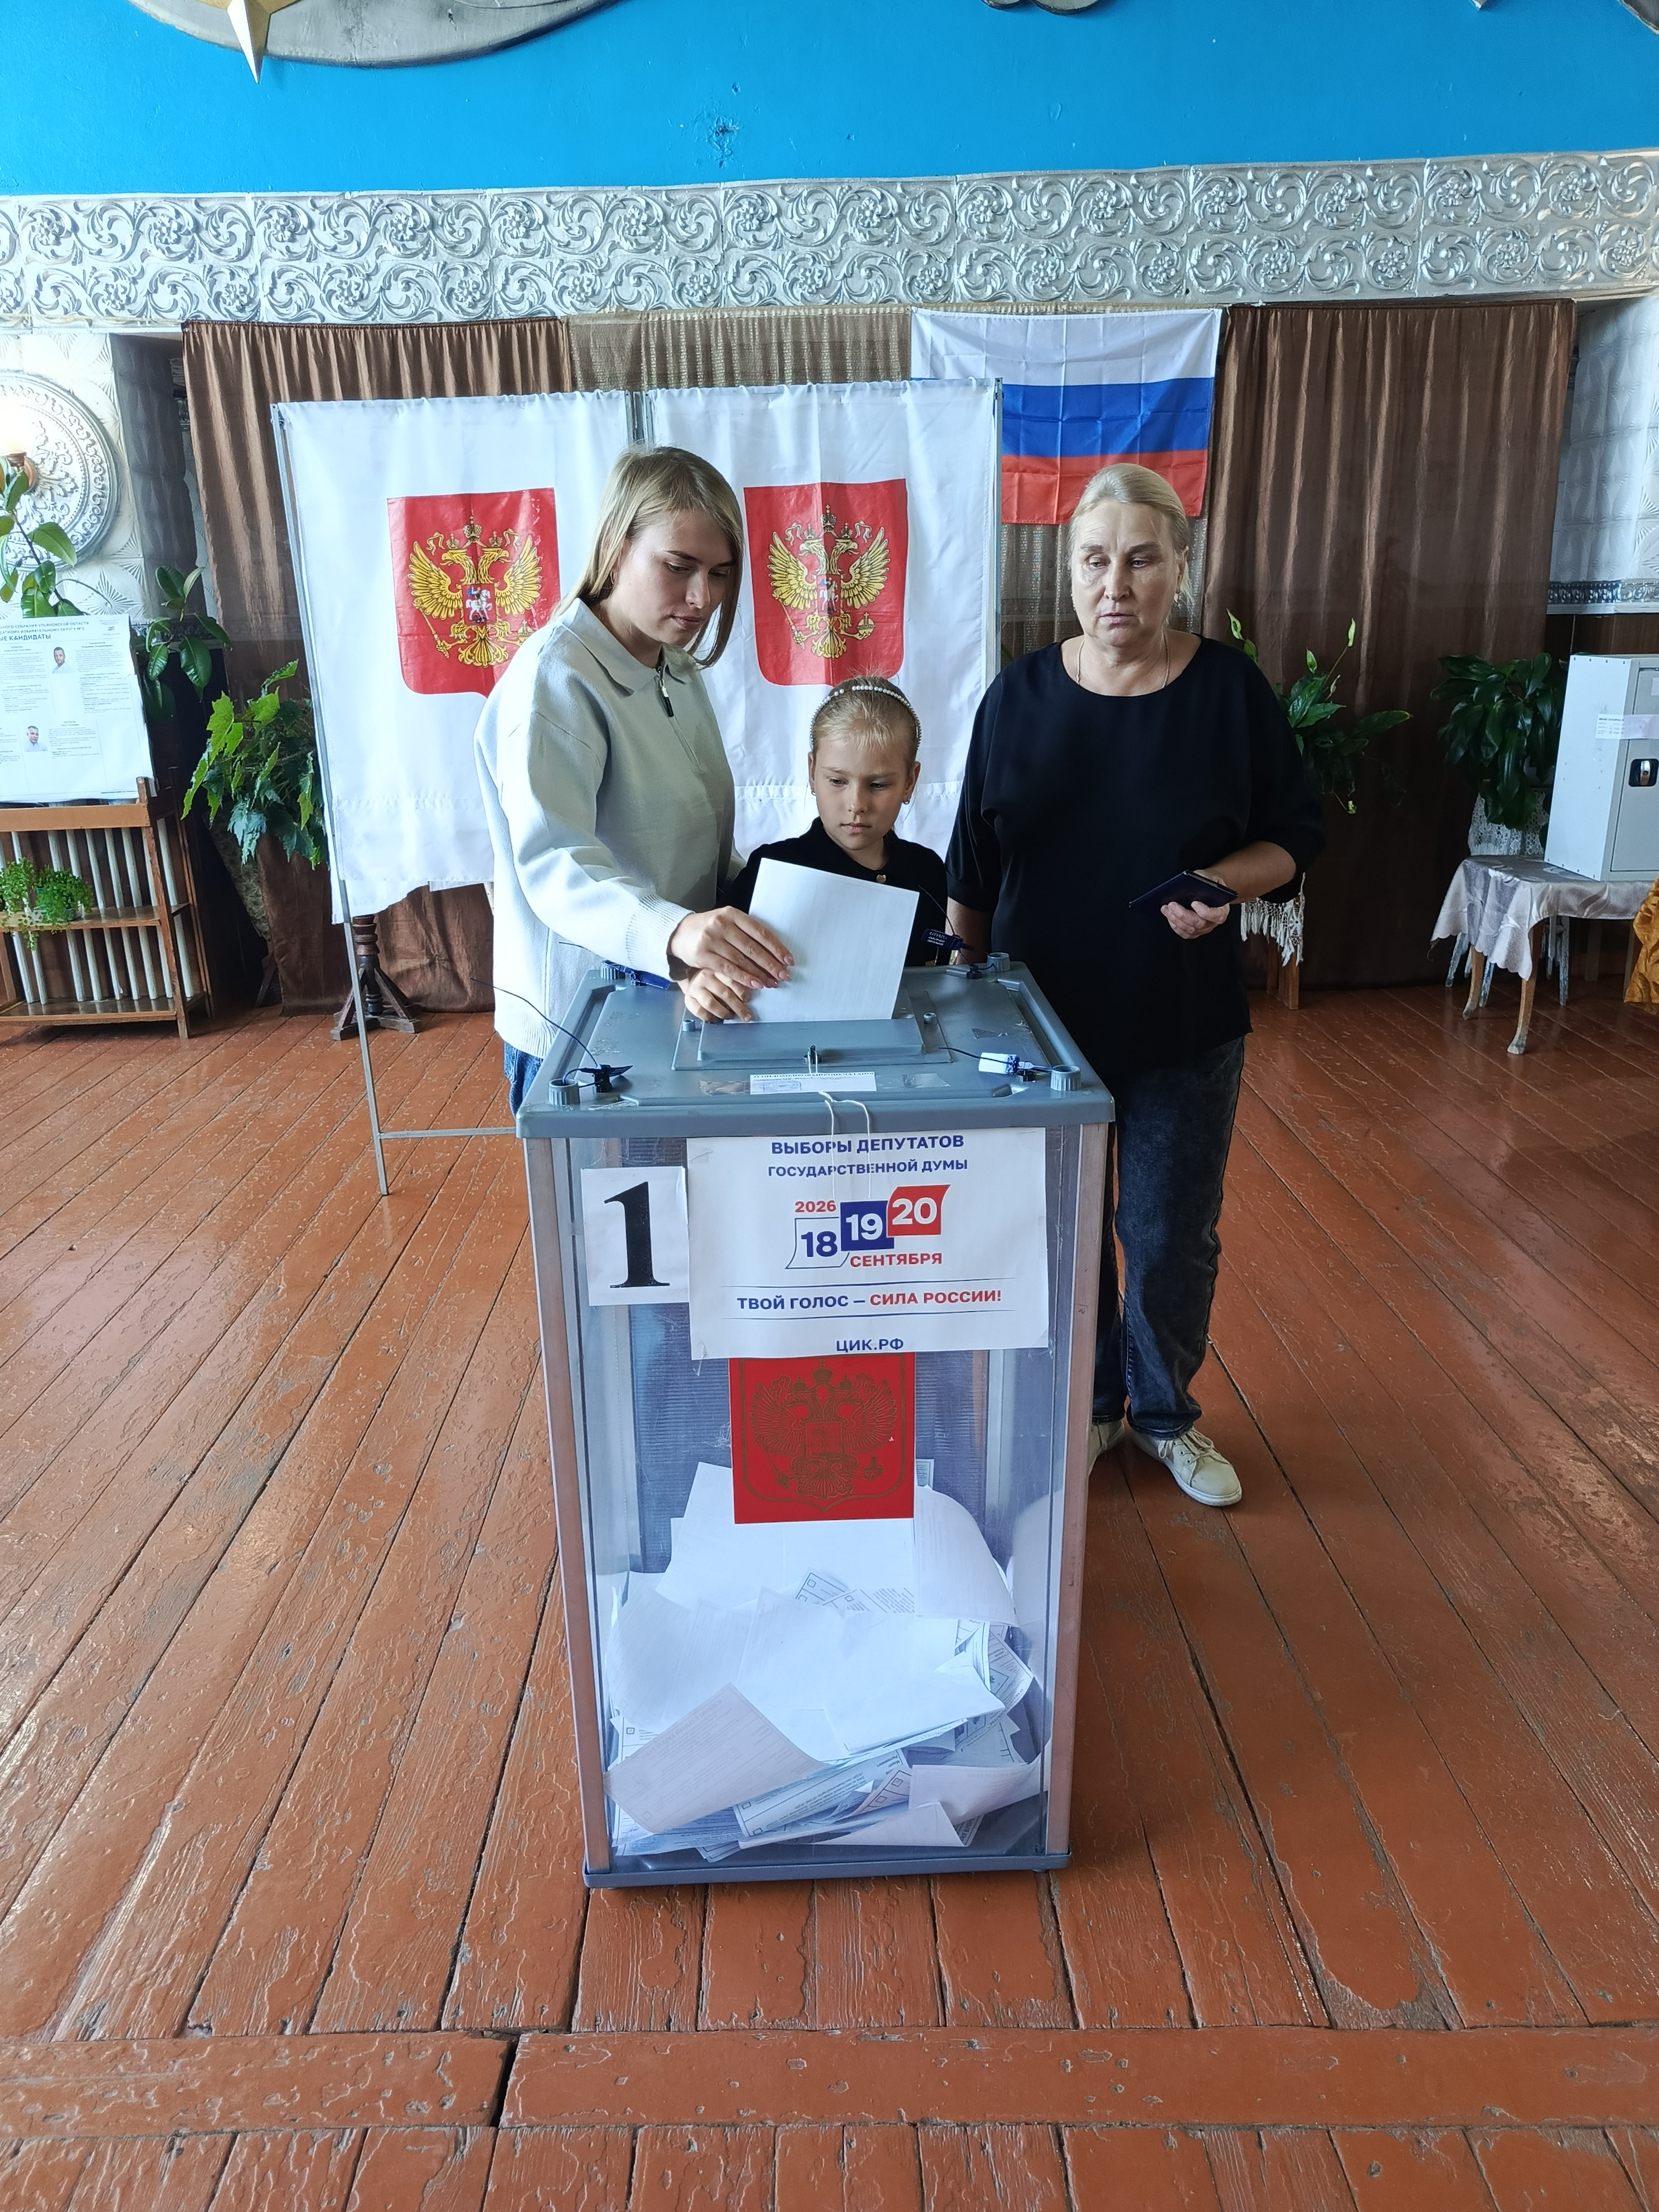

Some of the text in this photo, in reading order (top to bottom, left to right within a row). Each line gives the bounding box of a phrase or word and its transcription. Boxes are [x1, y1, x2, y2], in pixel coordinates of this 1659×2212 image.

[772, 1134, 964, 1154] ВЫБОРЫ ДЕПУТАТОВ
[768, 1158, 968, 1178] ГОСУДАРСТВЕННОЙ ДУМЫ
[794, 1200, 836, 1213] 2026
[604, 1181, 670, 1289] 1
[801, 1197, 938, 1258] 18 19 20
[850, 1253, 943, 1268] СЕНТЯБРЯ
[736, 1294, 785, 1310] ТВОЙ
[790, 1295, 849, 1309] ГОЛОС
[870, 1291, 919, 1306] СИЛА
[923, 1289, 1002, 1304] РОССИИ!
[836, 1337, 904, 1354] ЦИК.РФ
